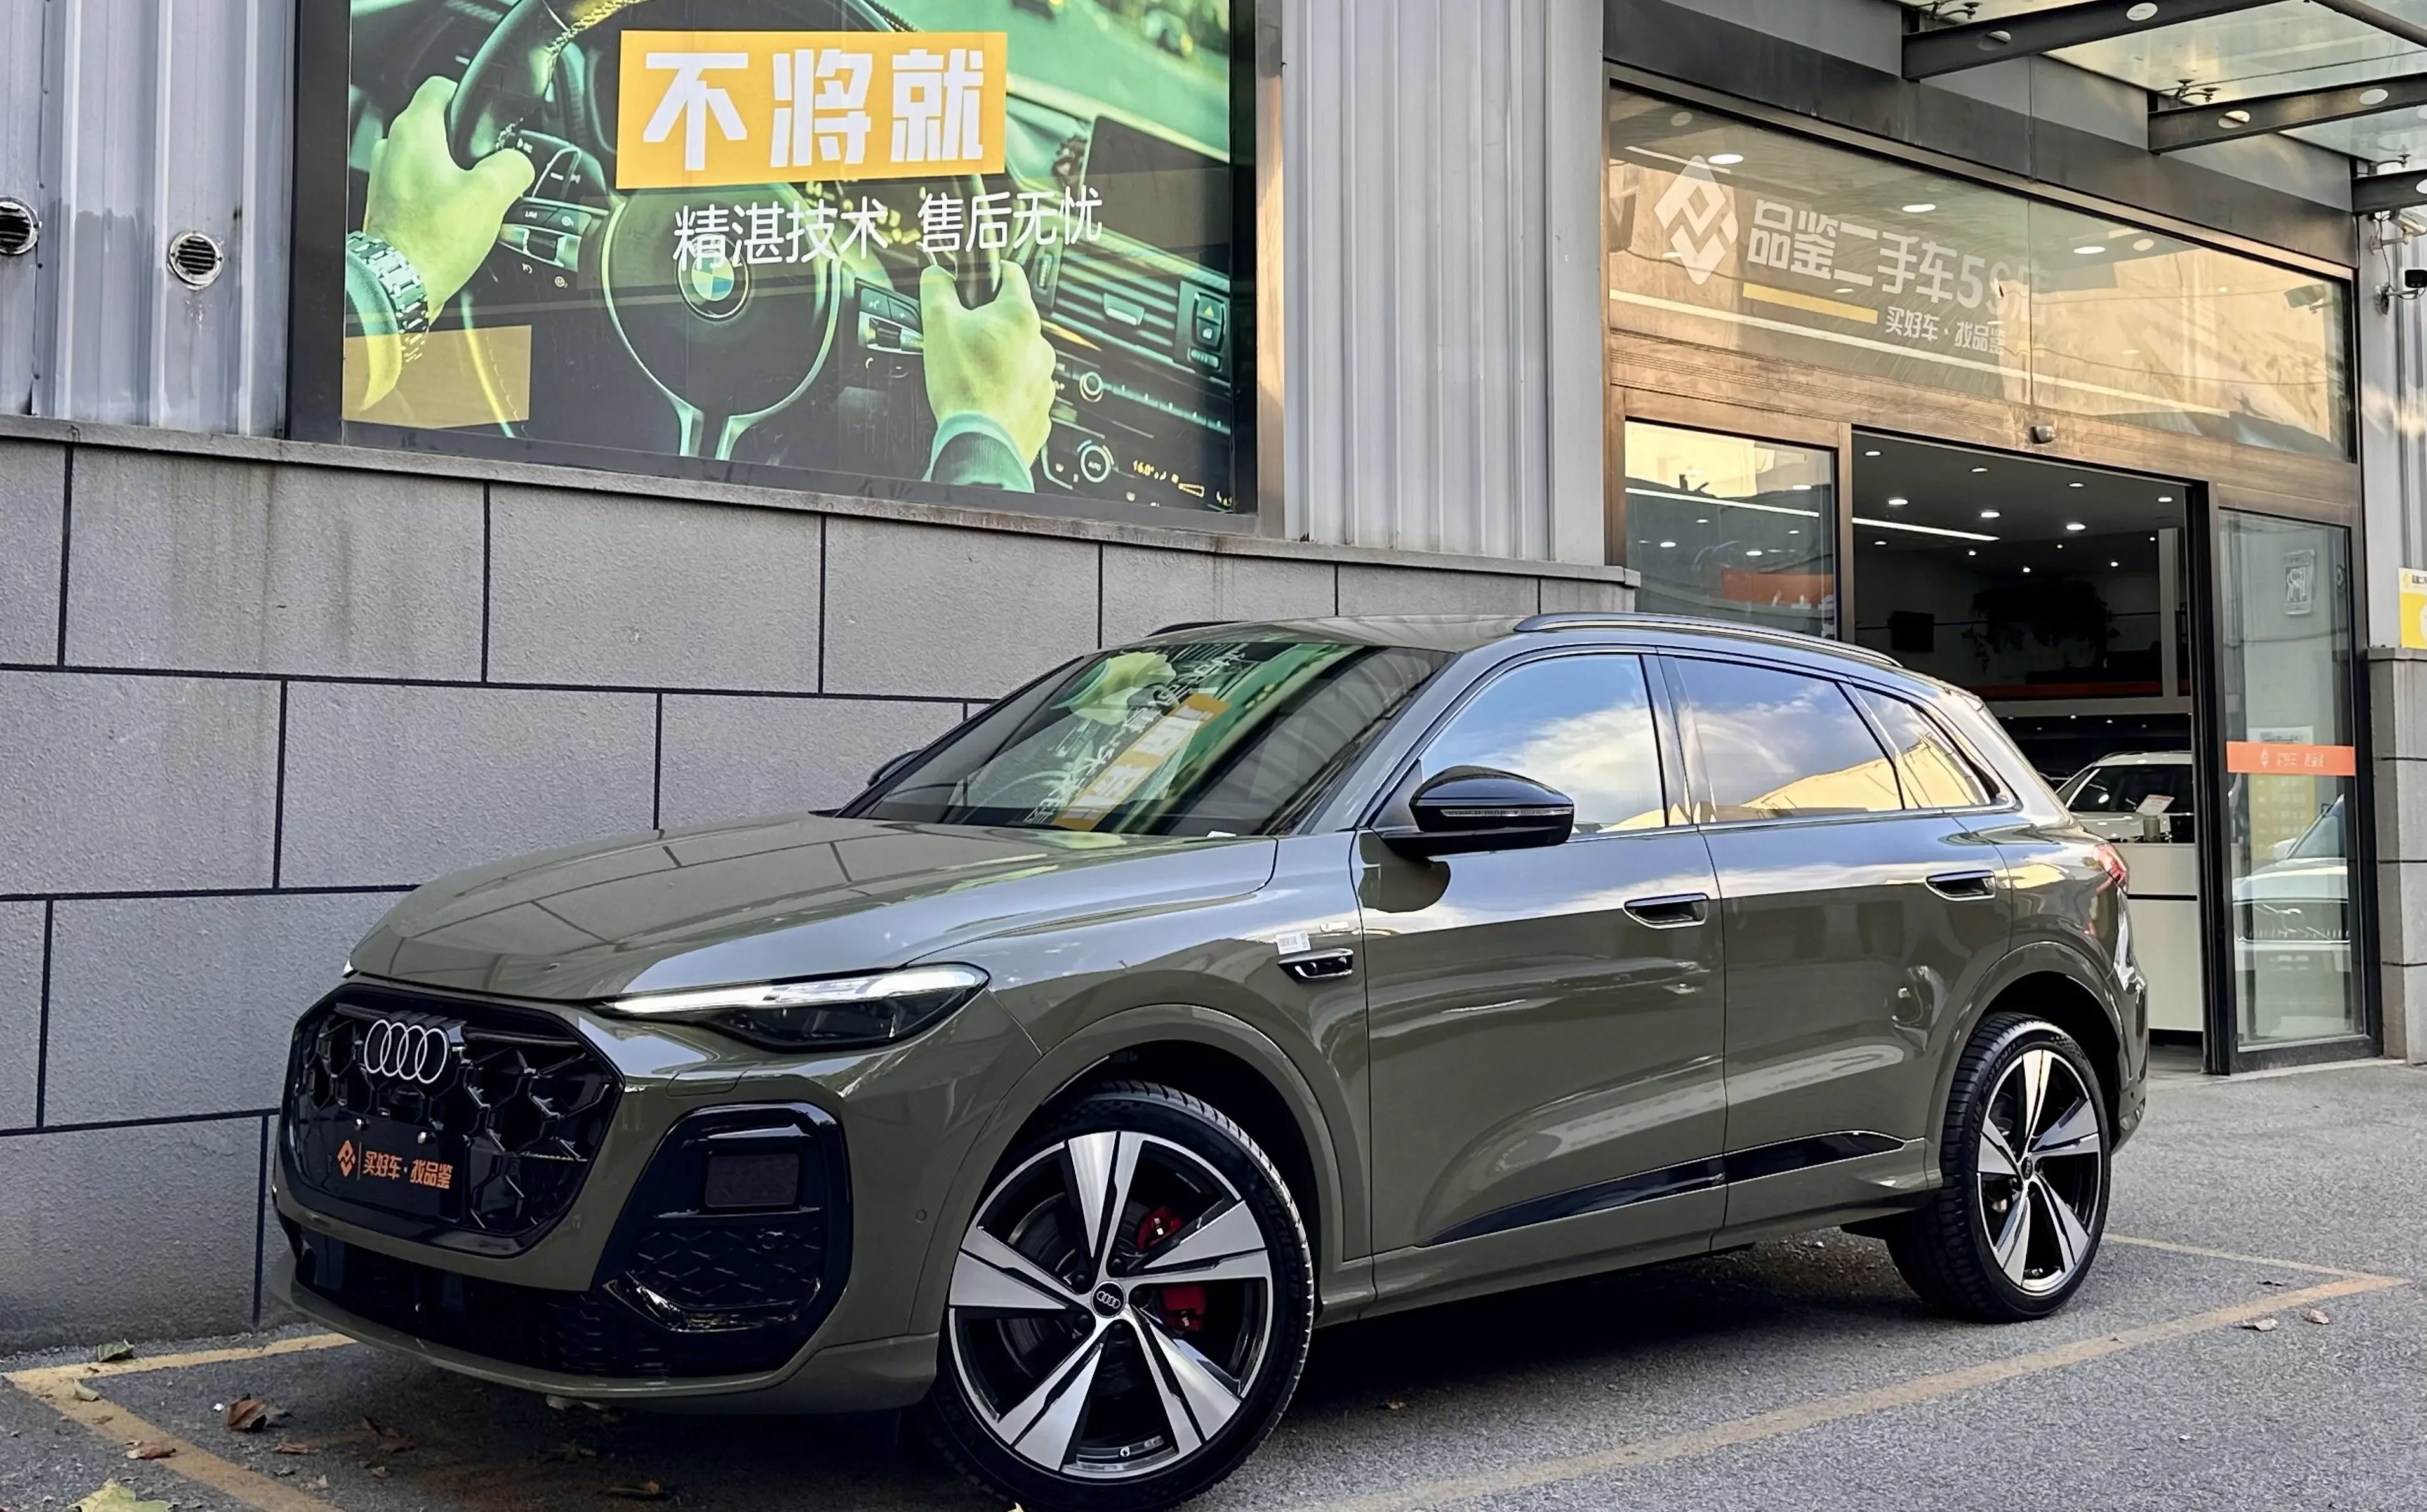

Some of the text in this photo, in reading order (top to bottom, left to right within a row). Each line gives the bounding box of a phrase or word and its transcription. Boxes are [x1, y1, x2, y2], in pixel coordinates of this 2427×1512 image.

[642, 48, 984, 171] 不将就
[673, 187, 1103, 272] 精湛技术 售后无忧
